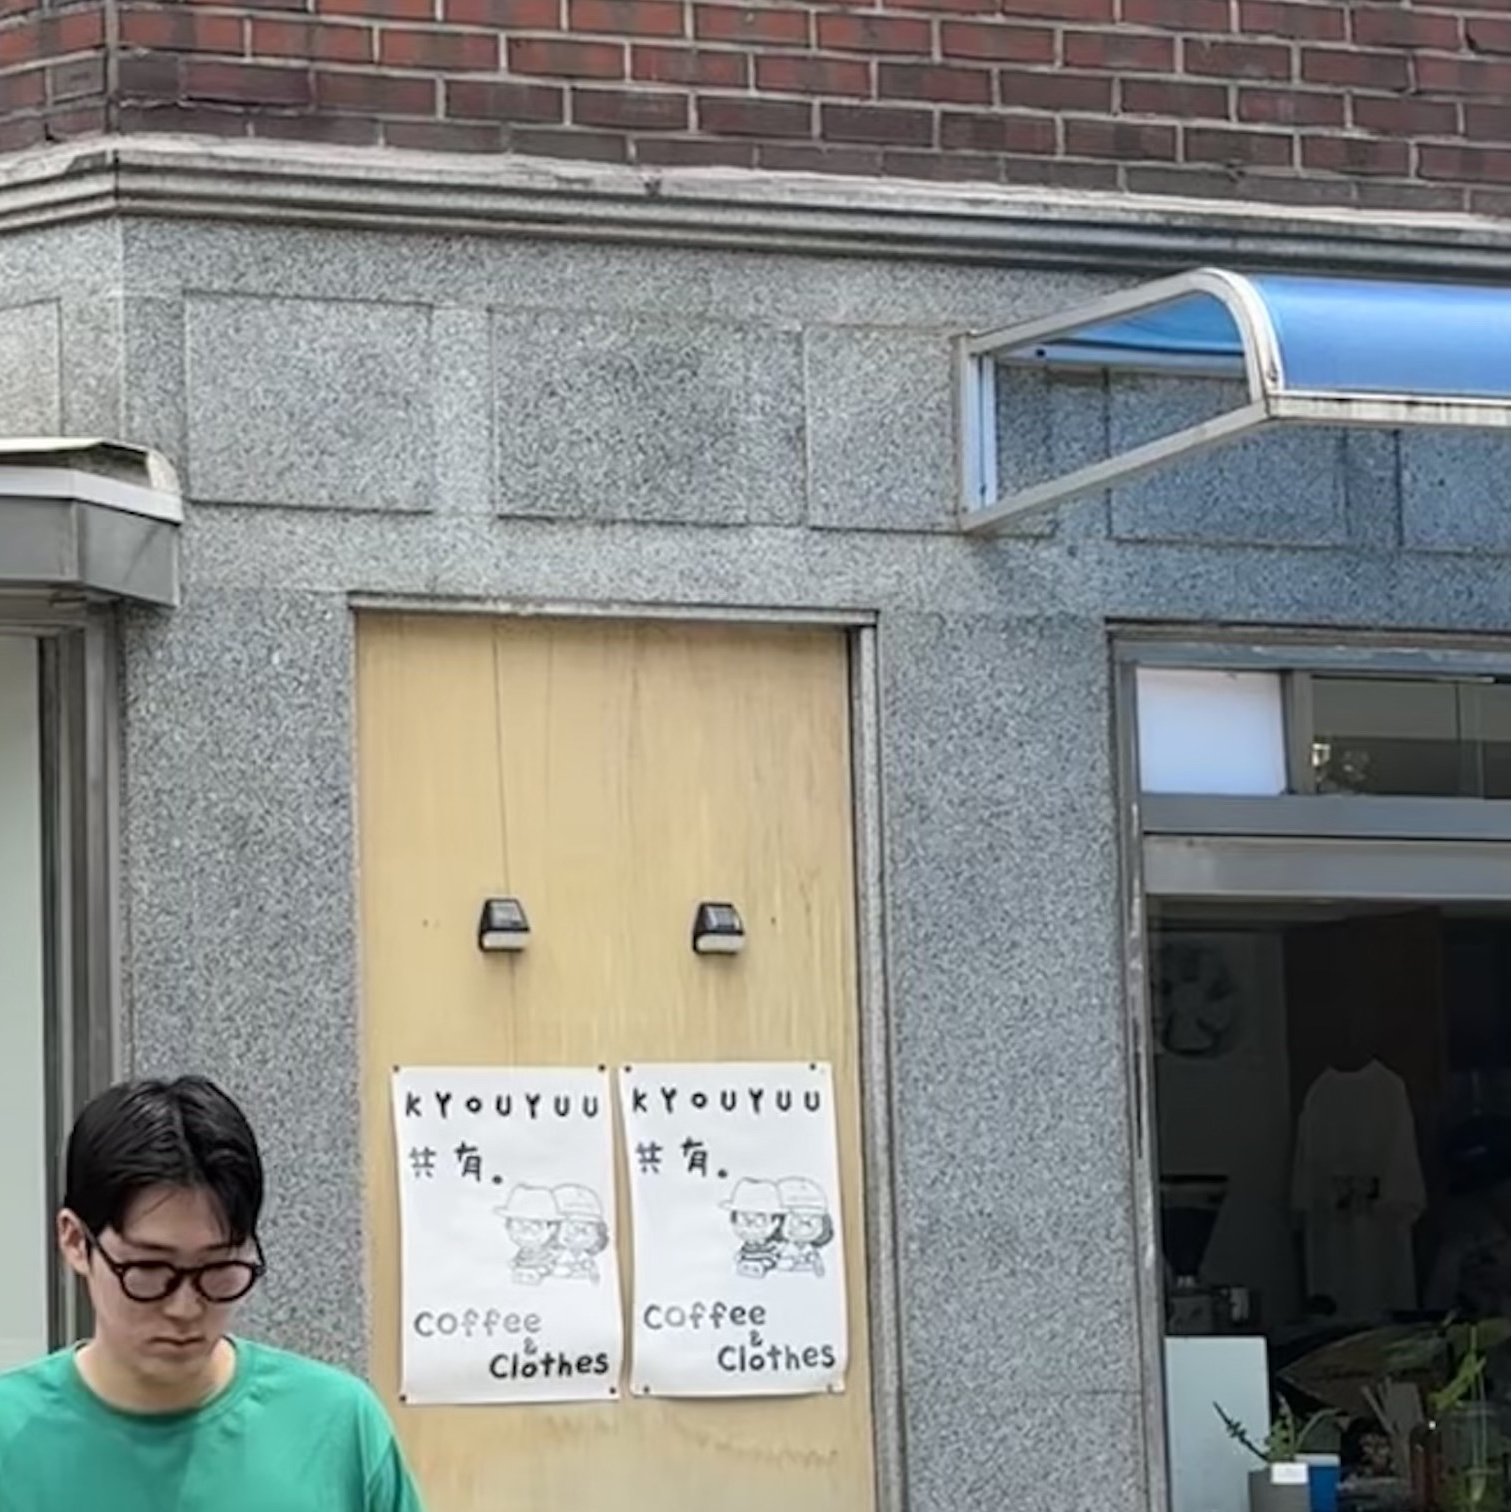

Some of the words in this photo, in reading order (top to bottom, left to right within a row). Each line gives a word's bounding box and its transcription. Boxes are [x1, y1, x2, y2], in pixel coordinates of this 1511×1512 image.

[405, 1091, 599, 1119] KYOUYUU
[632, 1086, 821, 1114] KYOUYUU
[413, 1308, 542, 1337] Coffee
[643, 1301, 767, 1330] Coffee
[523, 1336, 538, 1356] &
[749, 1329, 764, 1348] &
[489, 1352, 610, 1380] Clothes
[717, 1344, 836, 1372] Clothes
